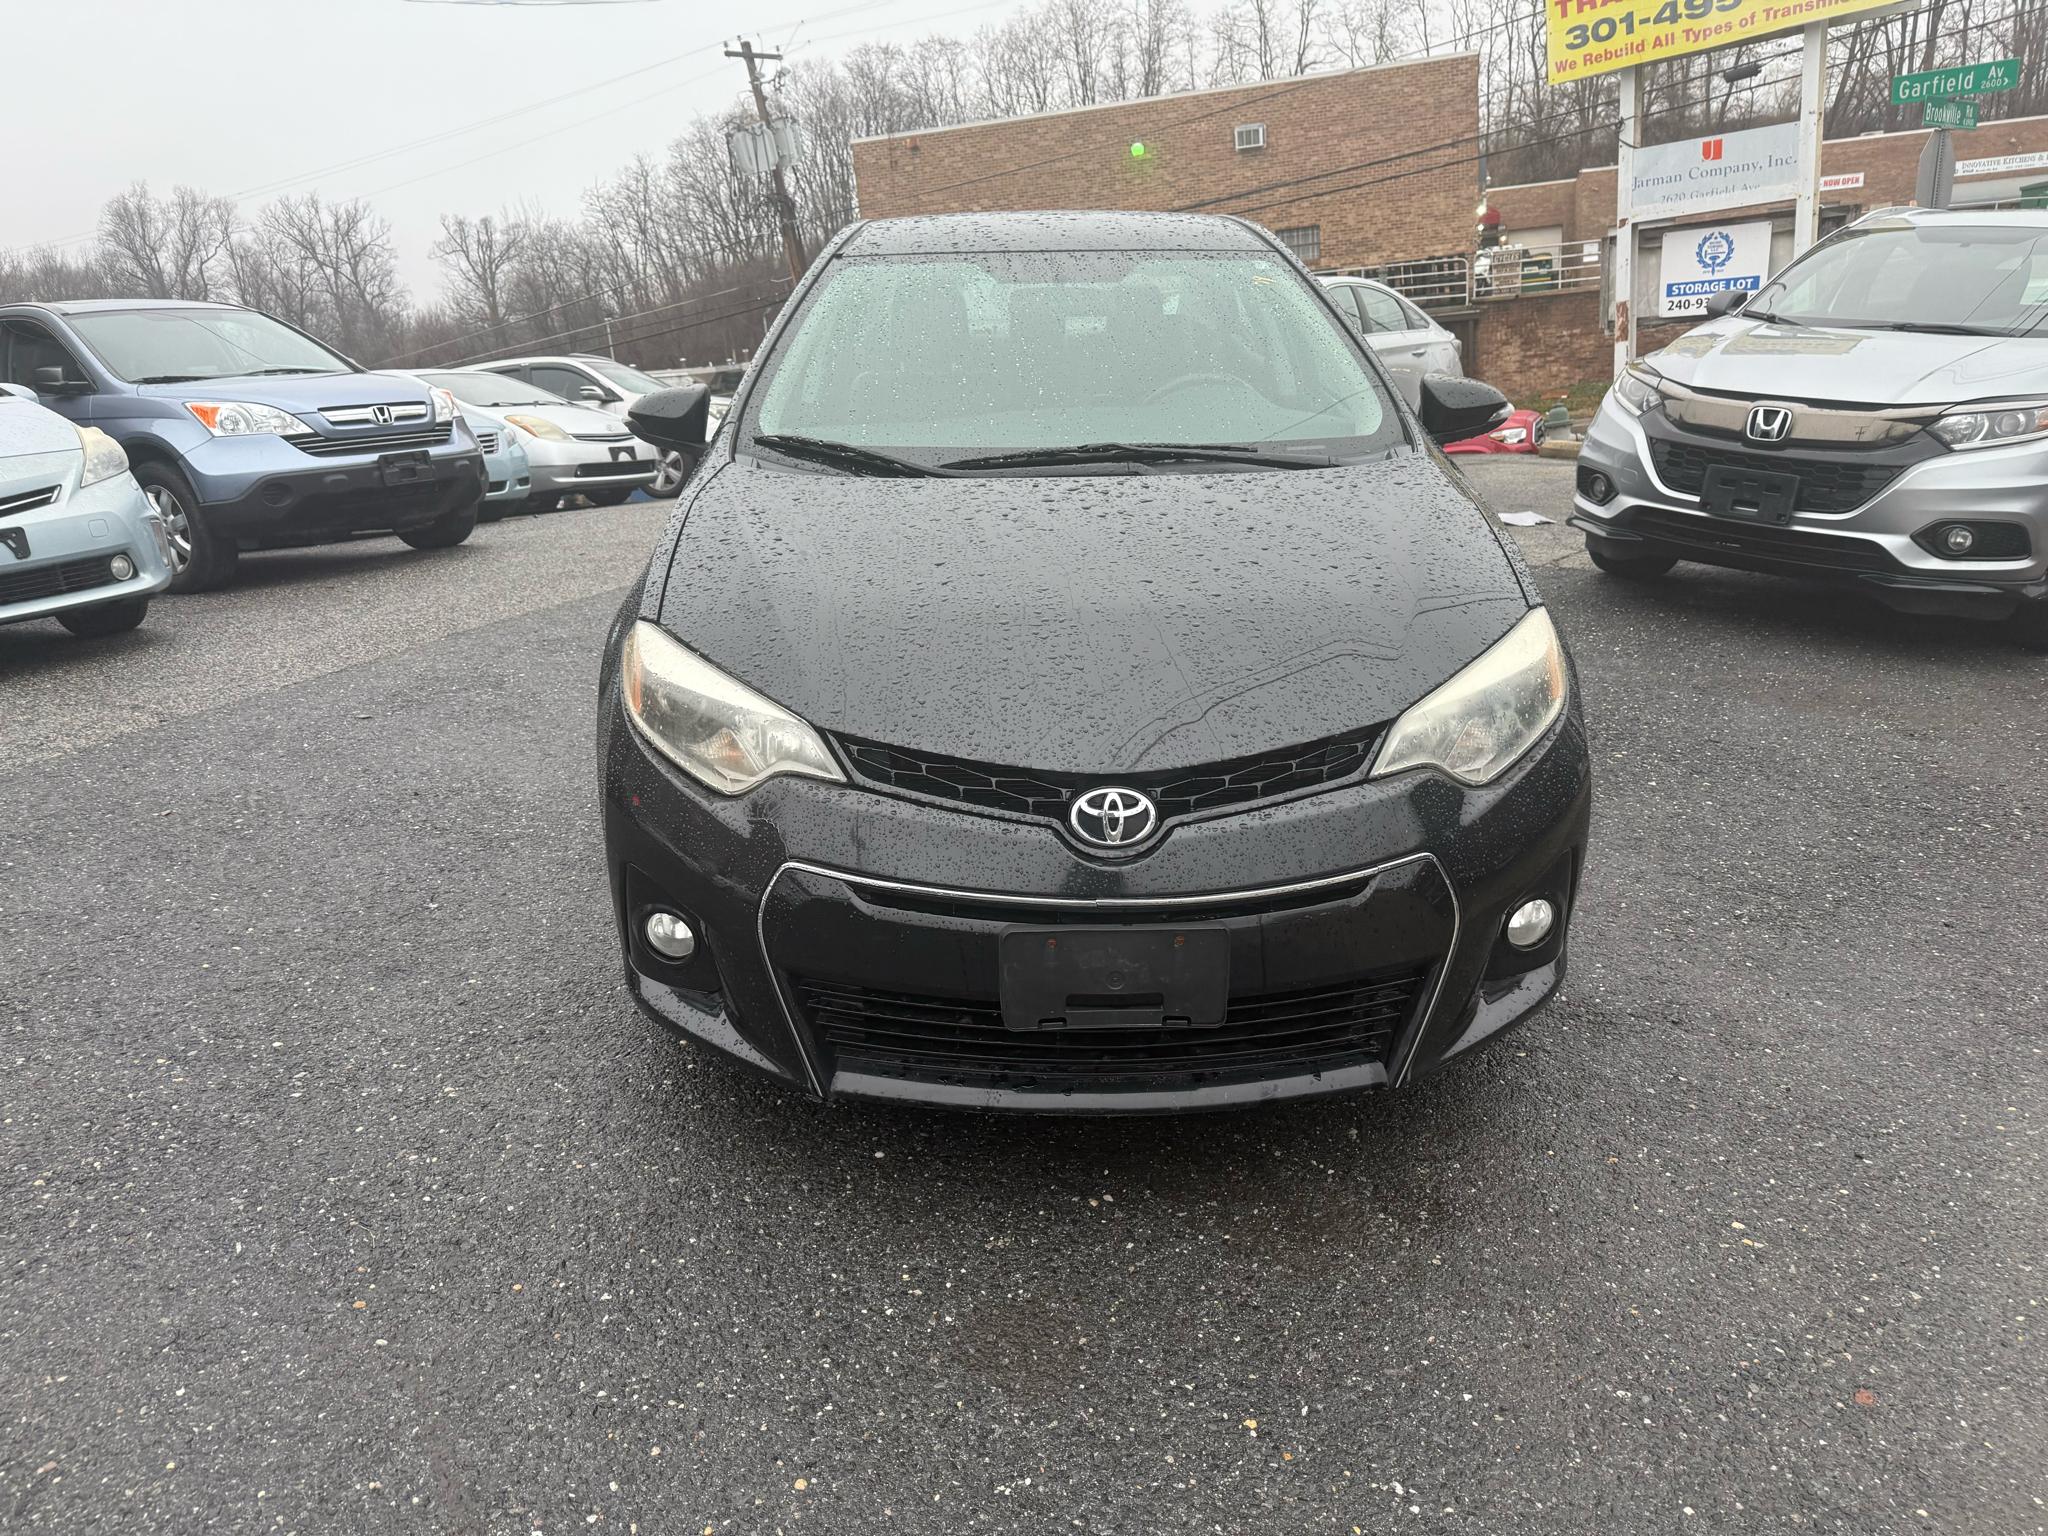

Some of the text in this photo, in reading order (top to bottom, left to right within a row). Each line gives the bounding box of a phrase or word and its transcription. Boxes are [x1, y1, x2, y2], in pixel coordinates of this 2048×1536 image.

[1555, 0, 1849, 74] We Rebuild All Types of Transm
[1899, 65, 2005, 99] Garfield Av
[1980, 78, 2002, 89] 2600
[1925, 102, 1961, 124] Brookville
[1632, 154, 1798, 192] Jarman Company, Inc.
[1823, 176, 1860, 187] NOW OPEN
[1671, 279, 1754, 295] STORAGE LOT
